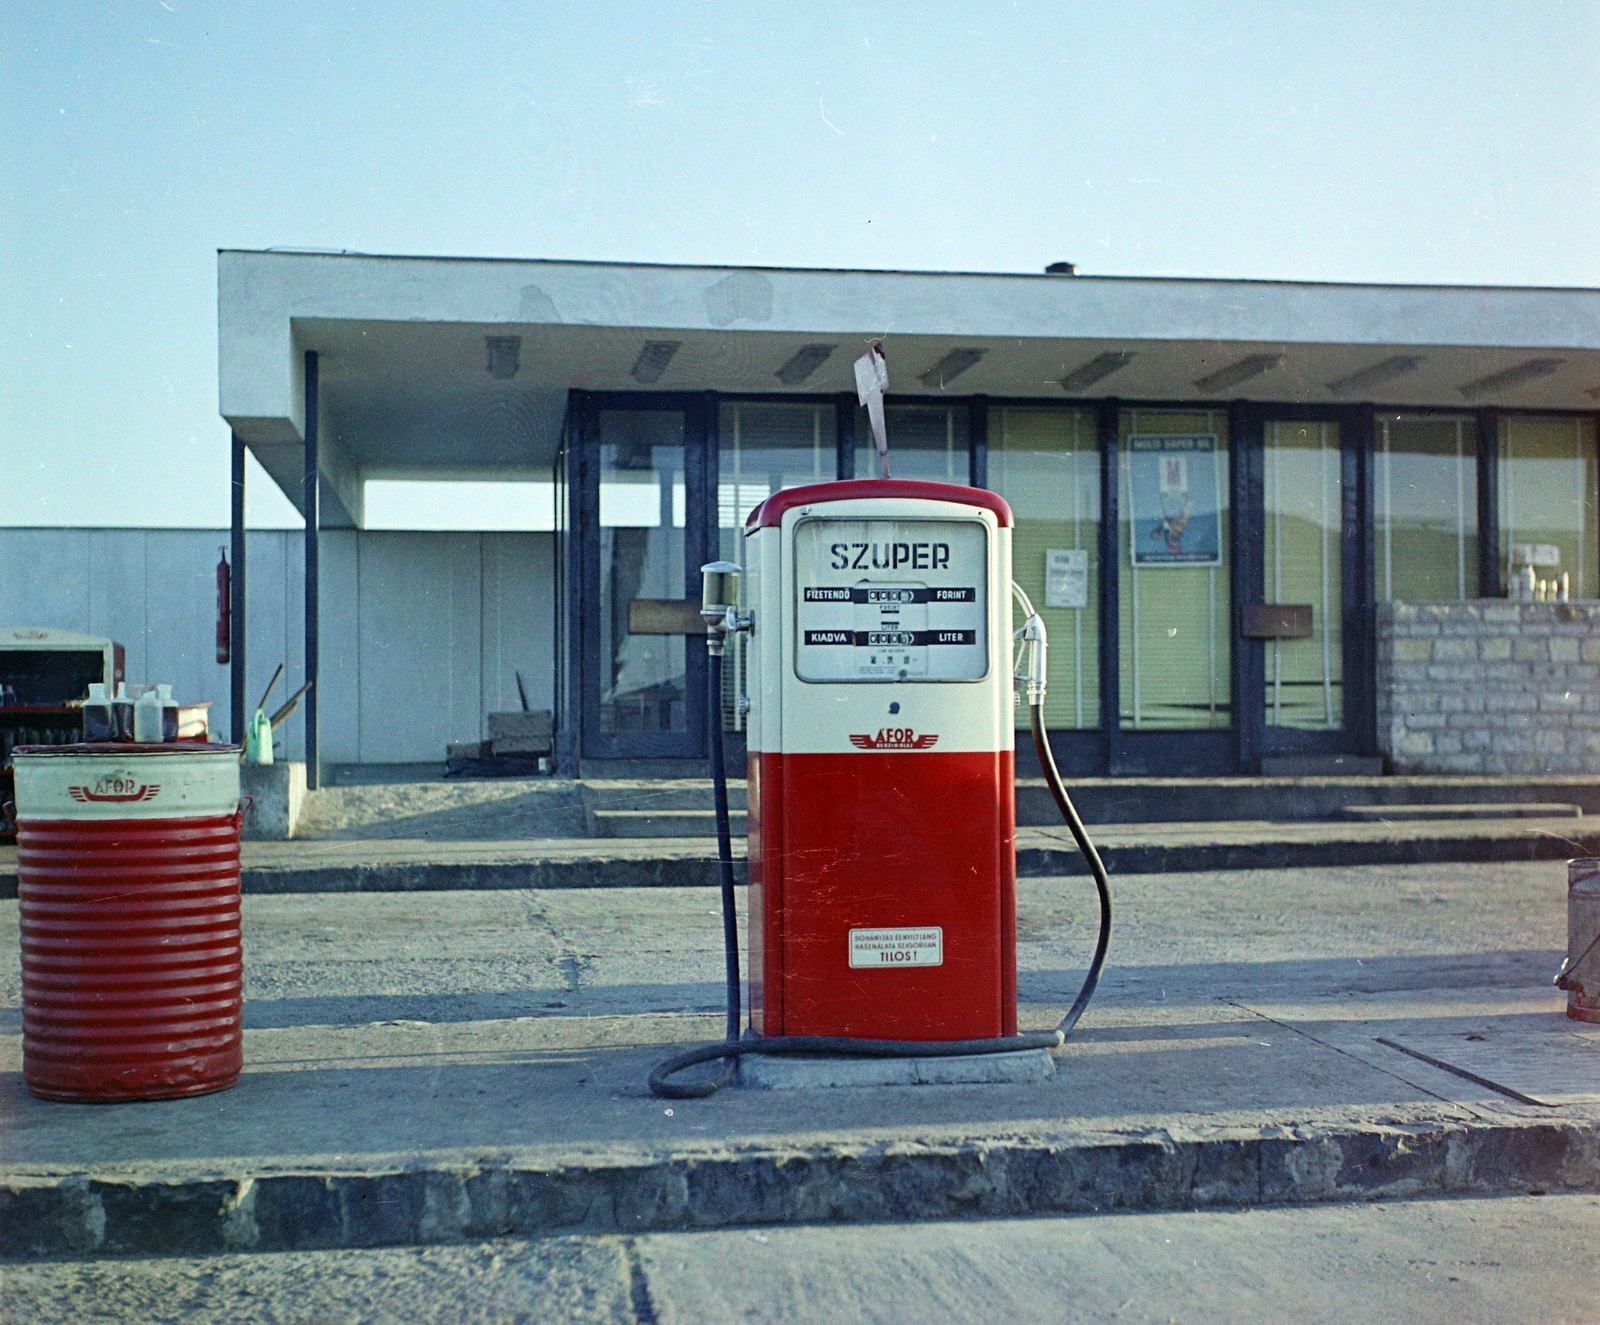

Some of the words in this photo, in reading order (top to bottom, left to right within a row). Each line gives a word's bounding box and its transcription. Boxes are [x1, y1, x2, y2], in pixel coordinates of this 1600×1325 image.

[831, 543, 950, 570] SZUPER
[936, 590, 967, 600] FORINT
[811, 632, 847, 642] KIADVA
[939, 632, 963, 642] LITER
